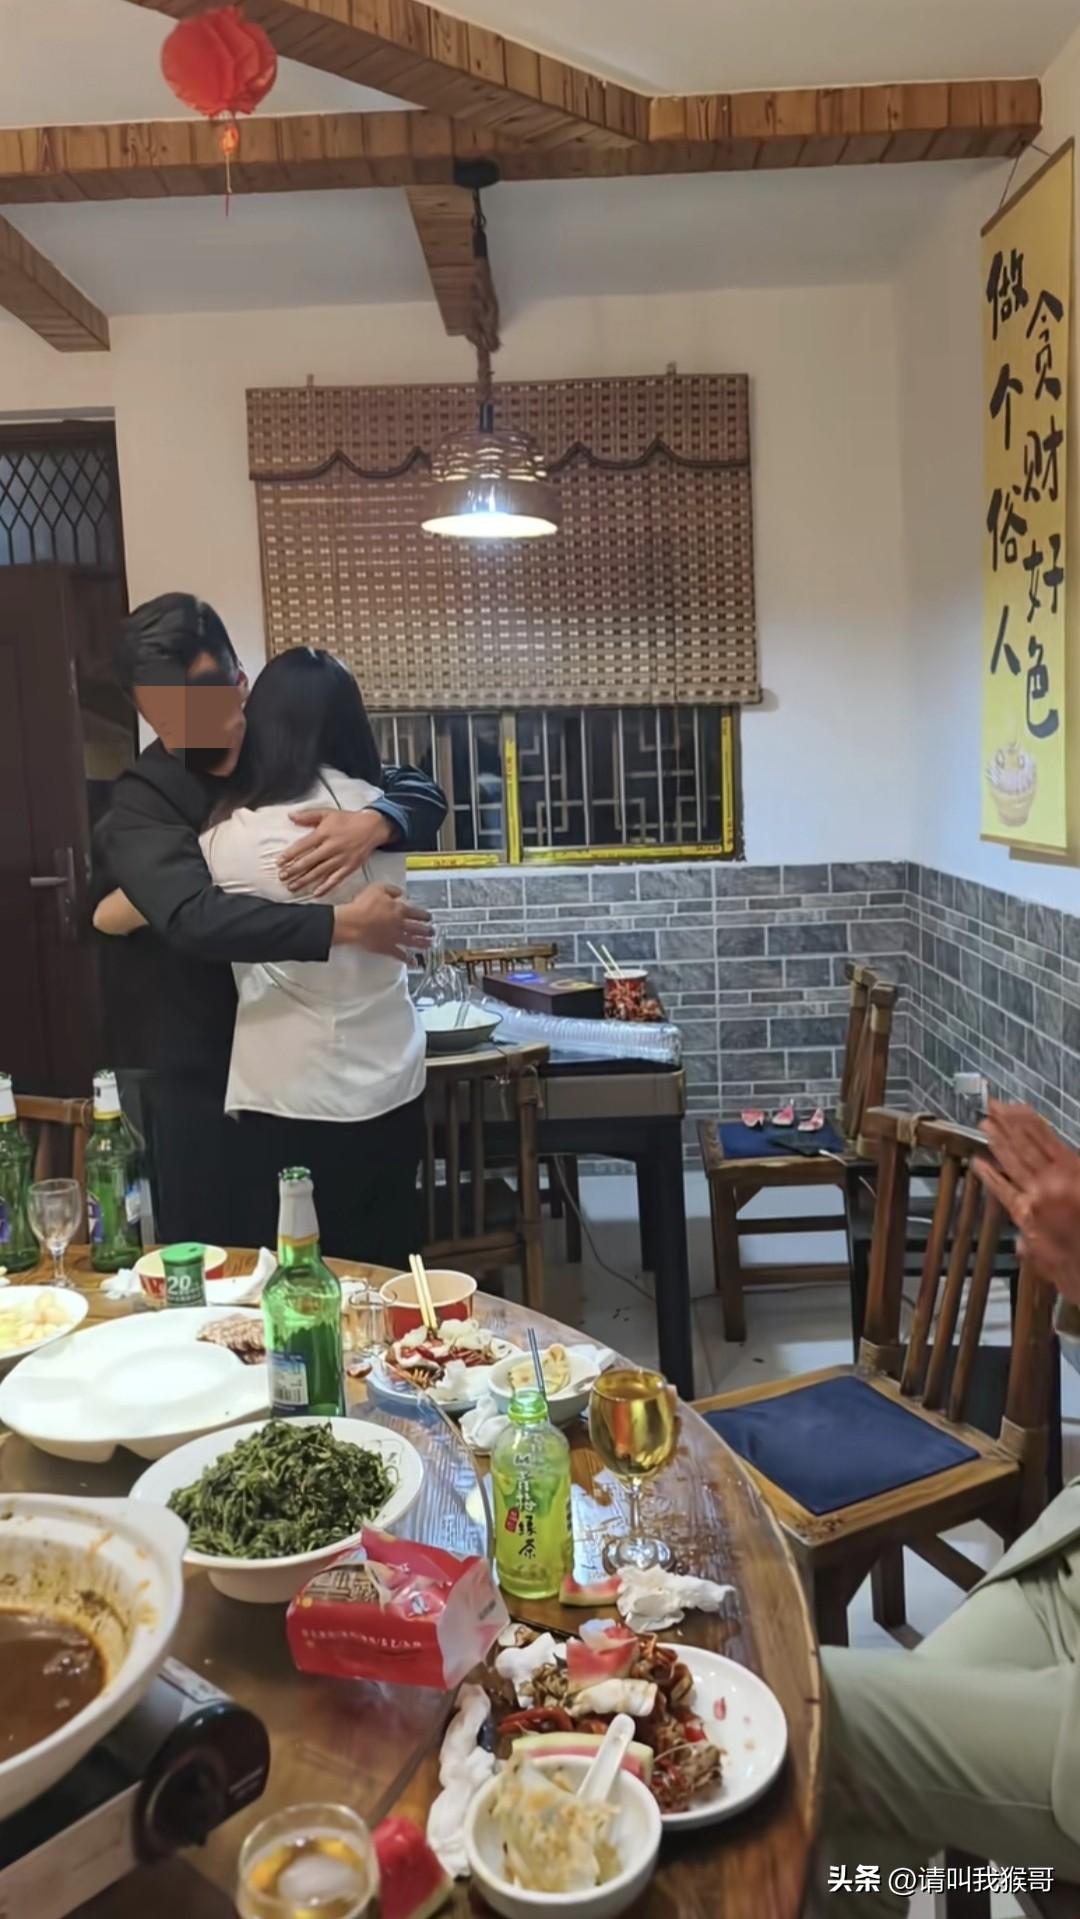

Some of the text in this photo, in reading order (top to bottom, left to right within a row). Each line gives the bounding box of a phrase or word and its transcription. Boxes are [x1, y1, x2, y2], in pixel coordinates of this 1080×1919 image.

[986, 249, 1028, 675] 做个俗人
[1023, 290, 1064, 738] 贪财好色
[167, 1275, 191, 1295] 20
